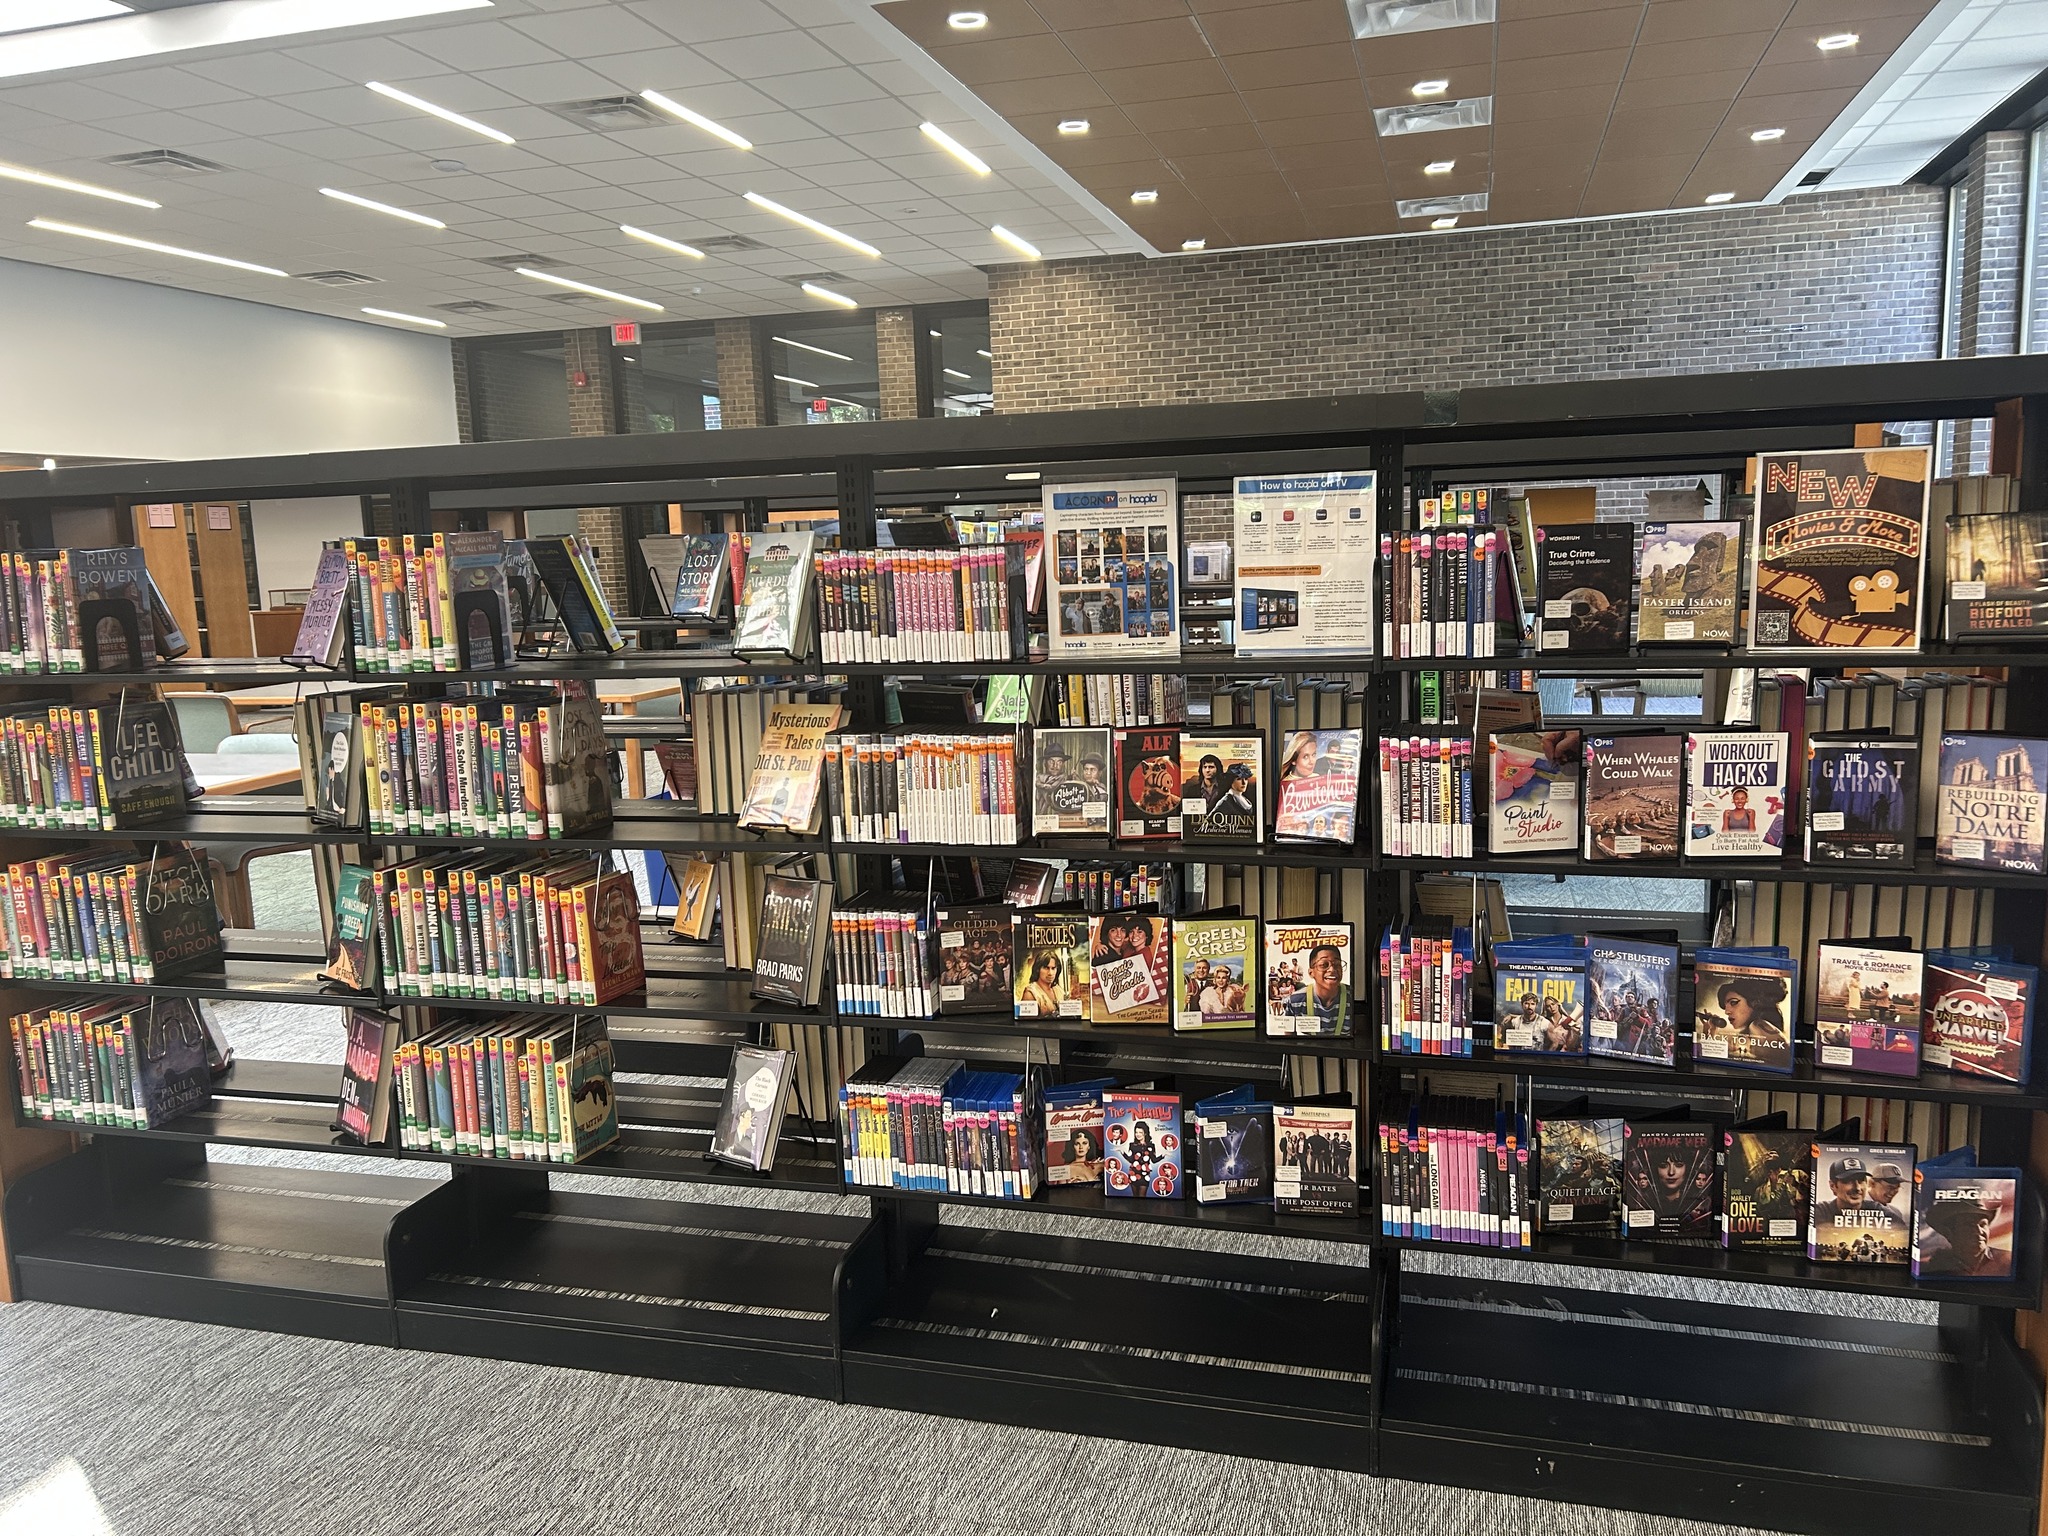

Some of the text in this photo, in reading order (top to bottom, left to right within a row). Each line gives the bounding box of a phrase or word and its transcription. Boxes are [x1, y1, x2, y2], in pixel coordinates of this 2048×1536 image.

[616, 324, 635, 342] EXIT
[814, 400, 828, 412] EXIT
[1260, 480, 1318, 490] How to hoopla
[1767, 461, 1879, 508] NEW
[1065, 495, 1105, 506] ACORN
[1129, 493, 1158, 505] hoopla
[457, 536, 493, 544] ALEXANDER
[1781, 517, 1904, 549] Movies & More
[478, 544, 497, 552] SMITH
[1549, 549, 1595, 559] True Crime
[86, 552, 128, 565] RHYS
[323, 555, 345, 569] SIMON
[687, 555, 718, 567] LOST
[1549, 559, 1574, 567] Decoding
[79, 570, 138, 584] BOWEN
[319, 570, 340, 584] BRETT
[680, 572, 714, 585] STORY
[750, 575, 795, 587] MURDER
[310, 599, 333, 613] MESSY
[1643, 597, 1732, 607] EASTER ISLAND
[1970, 607, 2032, 619] BIGFOOT
[303, 615, 331, 629] MURDER
[1970, 618, 2032, 629] REVEALED
[1702, 629, 1730, 638] NOVA
[1001, 694, 1026, 706] Nate
[994, 705, 1024, 720] Silver
[769, 712, 831, 730] Mysterious
[120, 722, 160, 750] LEE
[785, 734, 811, 750] Tales
[1142, 736, 1172, 751] ALF
[1596, 752, 1679, 767] WHEN WHALES
[1709, 743, 1773, 760] WORKOUT
[1844, 753, 1863, 763] THE
[110, 751, 175, 781] CHILD
[418, 747, 429, 779] MOSLEY
[754, 755, 813, 771] Old St. Paul
[1822, 760, 1906, 779] GHOST
[456, 732, 470, 816] We Solve Murders
[1602, 766, 1673, 780] COULD WALK
[1713, 763, 1768, 786] HACKS
[1464, 778, 1472, 803] NATIVE
[1833, 775, 1901, 793] ARMY
[1055, 786, 1078, 802] Abbott
[1281, 769, 1352, 816] Bewitched
[1947, 788, 2040, 805] REBUILDING
[121, 796, 176, 813] SAFE ENOUGH
[1504, 800, 1549, 824] Paint
[1948, 799, 2037, 823] NOTRE
[1212, 812, 1255, 826] QUINN
[1517, 814, 1564, 838] Studio
[1955, 816, 2029, 840] DAME
[1711, 843, 1763, 852] Live Healthy
[2006, 860, 2039, 871] NOVA
[341, 896, 369, 916] PUNISHING
[451, 898, 462, 920] ROBB
[467, 899, 478, 922] ROBB
[343, 914, 361, 930] BREED
[426, 896, 439, 938] RANKIN
[953, 919, 998, 929] GILDED
[163, 921, 206, 943] PAUL
[965, 929, 988, 938] AGE
[1026, 924, 1076, 948] HERCULES
[1183, 925, 1247, 947] GREEN
[1275, 929, 1320, 944] FAMILY
[155, 934, 218, 964] DOIRON
[1185, 939, 1247, 960] ACRES
[1283, 935, 1348, 954] MATTERS
[756, 959, 804, 983] BRAD PARKS
[1509, 964, 1545, 972] THEATRICAL
[1634, 961, 1665, 971] EMPIRE
[1832, 958, 1862, 966] TRAVEL
[1871, 961, 1912, 971] ROMANCE
[1865, 966, 1905, 974] COLLECTION
[1505, 978, 1576, 1004] FALL GUY
[1938, 996, 2005, 1022] ICONS
[1932, 1021, 2006, 1045] MARVEL
[1700, 1033, 1785, 1050] BACK TO BLACK
[530, 1070, 538, 1086] CITY
[160, 1078, 196, 1096] PAULA
[341, 1077, 357, 1104] DEN
[156, 1087, 204, 1112] MUNIER
[548, 1099, 556, 1115] DARK
[1108, 1104, 1173, 1121] The Nanny
[1550, 1186, 1616, 1198] QUIET PLACE
[1935, 1190, 2002, 1199] REAGAN
[1318, 1200, 1353, 1208] OFFICE
[1730, 1202, 1757, 1217] ONE
[1841, 1209, 1885, 1218] YOU GOTTA
[1730, 1218, 1764, 1233] LOVE
[1834, 1216, 1893, 1229] BELIEVE
